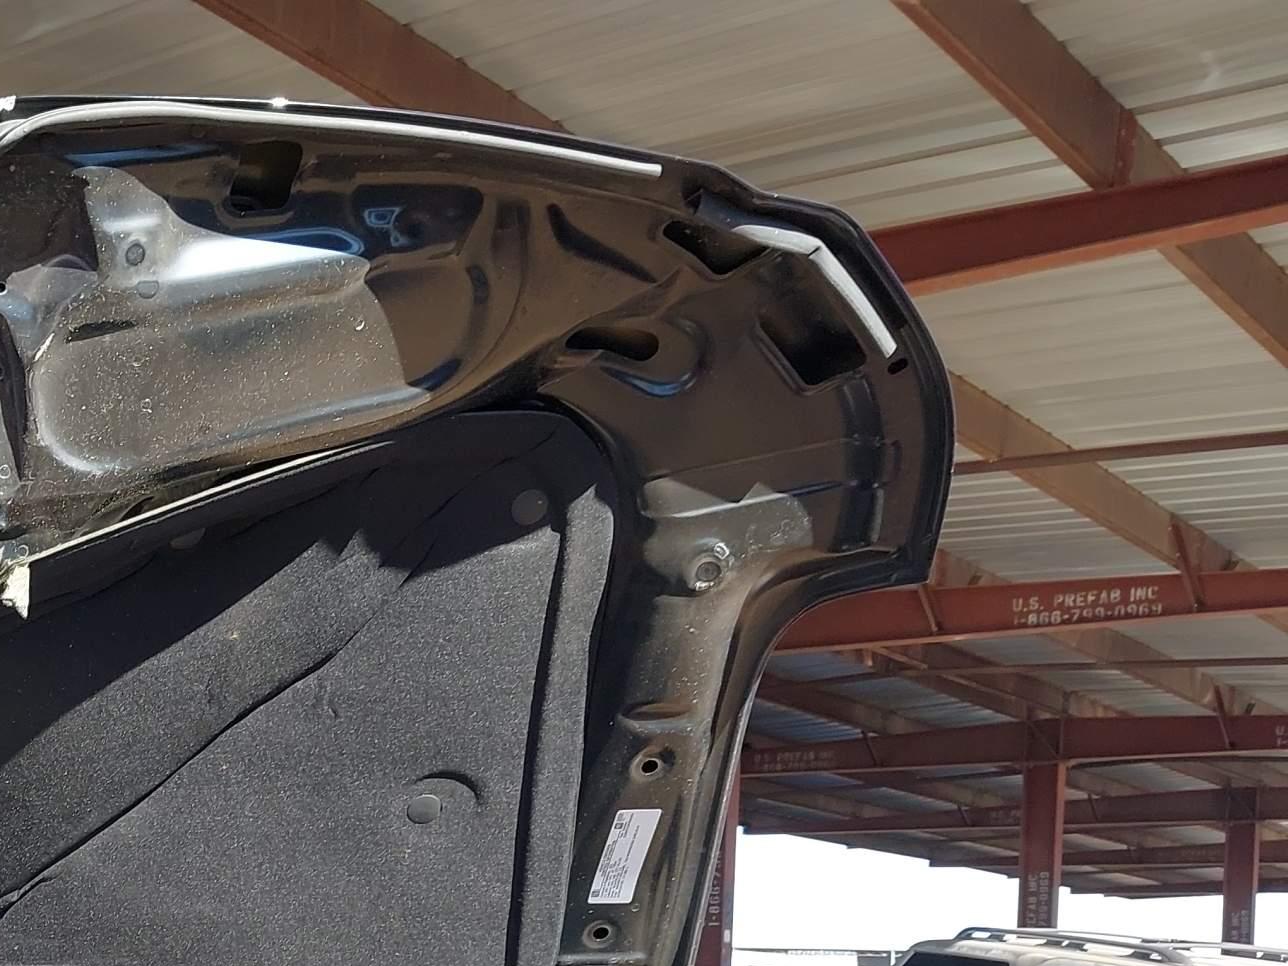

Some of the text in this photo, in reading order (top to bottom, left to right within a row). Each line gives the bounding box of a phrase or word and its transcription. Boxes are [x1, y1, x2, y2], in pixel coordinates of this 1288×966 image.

[1012, 585, 1160, 612] U.S. PREFAB INC
